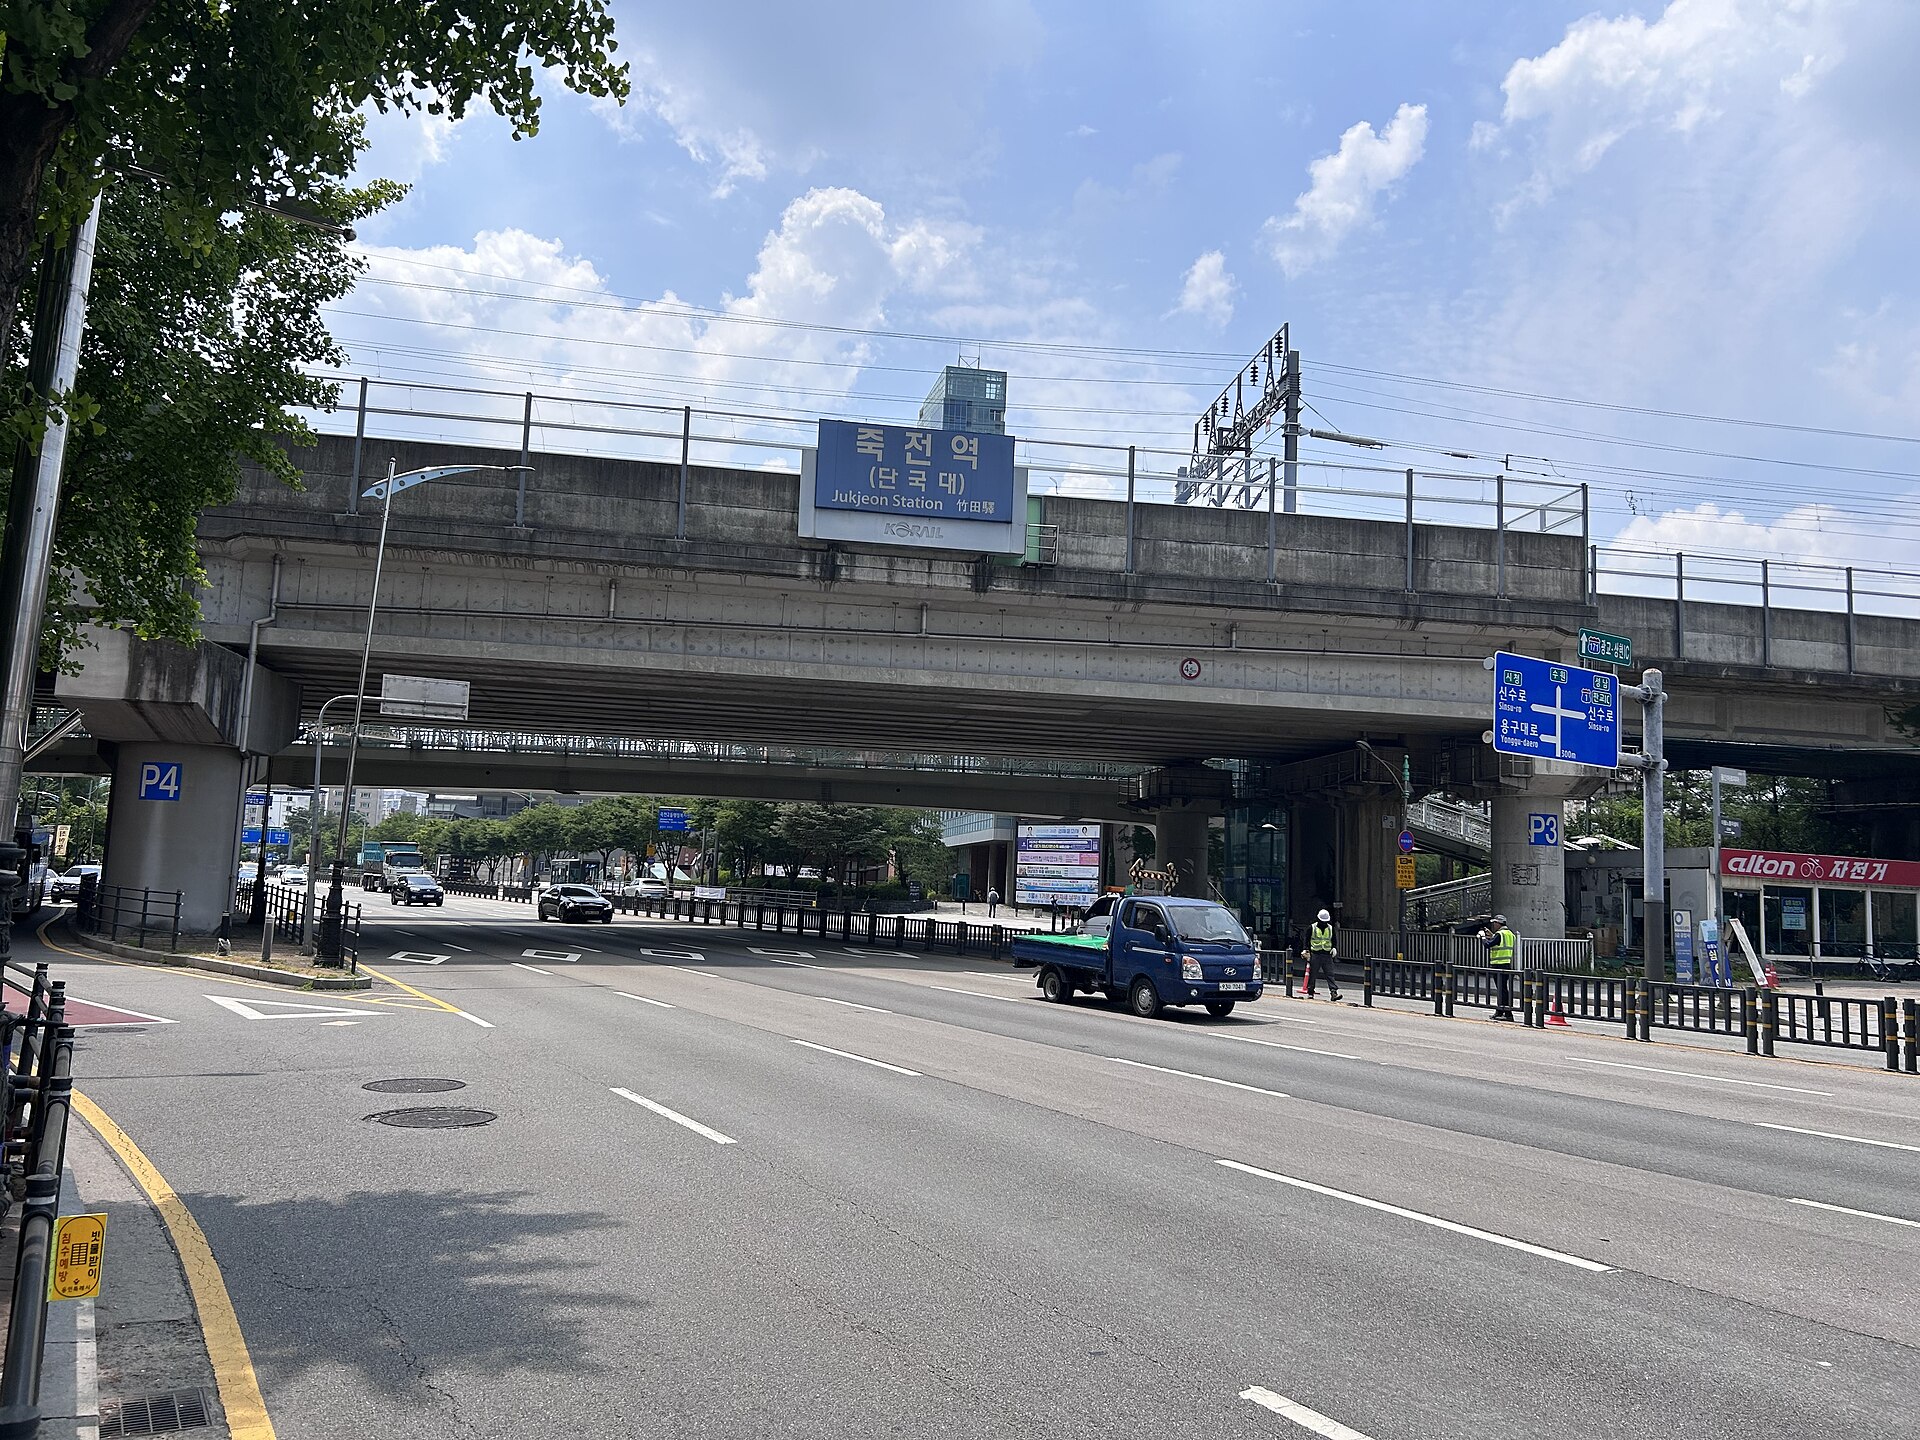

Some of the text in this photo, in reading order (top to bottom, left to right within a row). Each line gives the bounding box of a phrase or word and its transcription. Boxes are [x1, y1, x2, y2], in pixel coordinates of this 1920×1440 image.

[832, 489, 943, 511] Jukjeon Station
[883, 521, 944, 539] KORAIL
[1506, 673, 1520, 685] 시청
[1499, 686, 1527, 702] 신수로
[1499, 701, 1522, 713] Sinsu-ro
[1588, 706, 1614, 722] 신수로
[1500, 718, 1539, 737] 용구대로
[1588, 721, 1610, 733] Sinsu-ro
[1500, 734, 1539, 749] Yonggu-daero
[1561, 749, 1577, 759] 300m
[140, 764, 179, 798] P4
[1530, 815, 1558, 844] P3
[1727, 854, 1796, 876] alton
[1828, 860, 1889, 881] 자전거
[58, 1232, 71, 1283] 침수예방
[87, 1230, 101, 1279] 빗물받이
